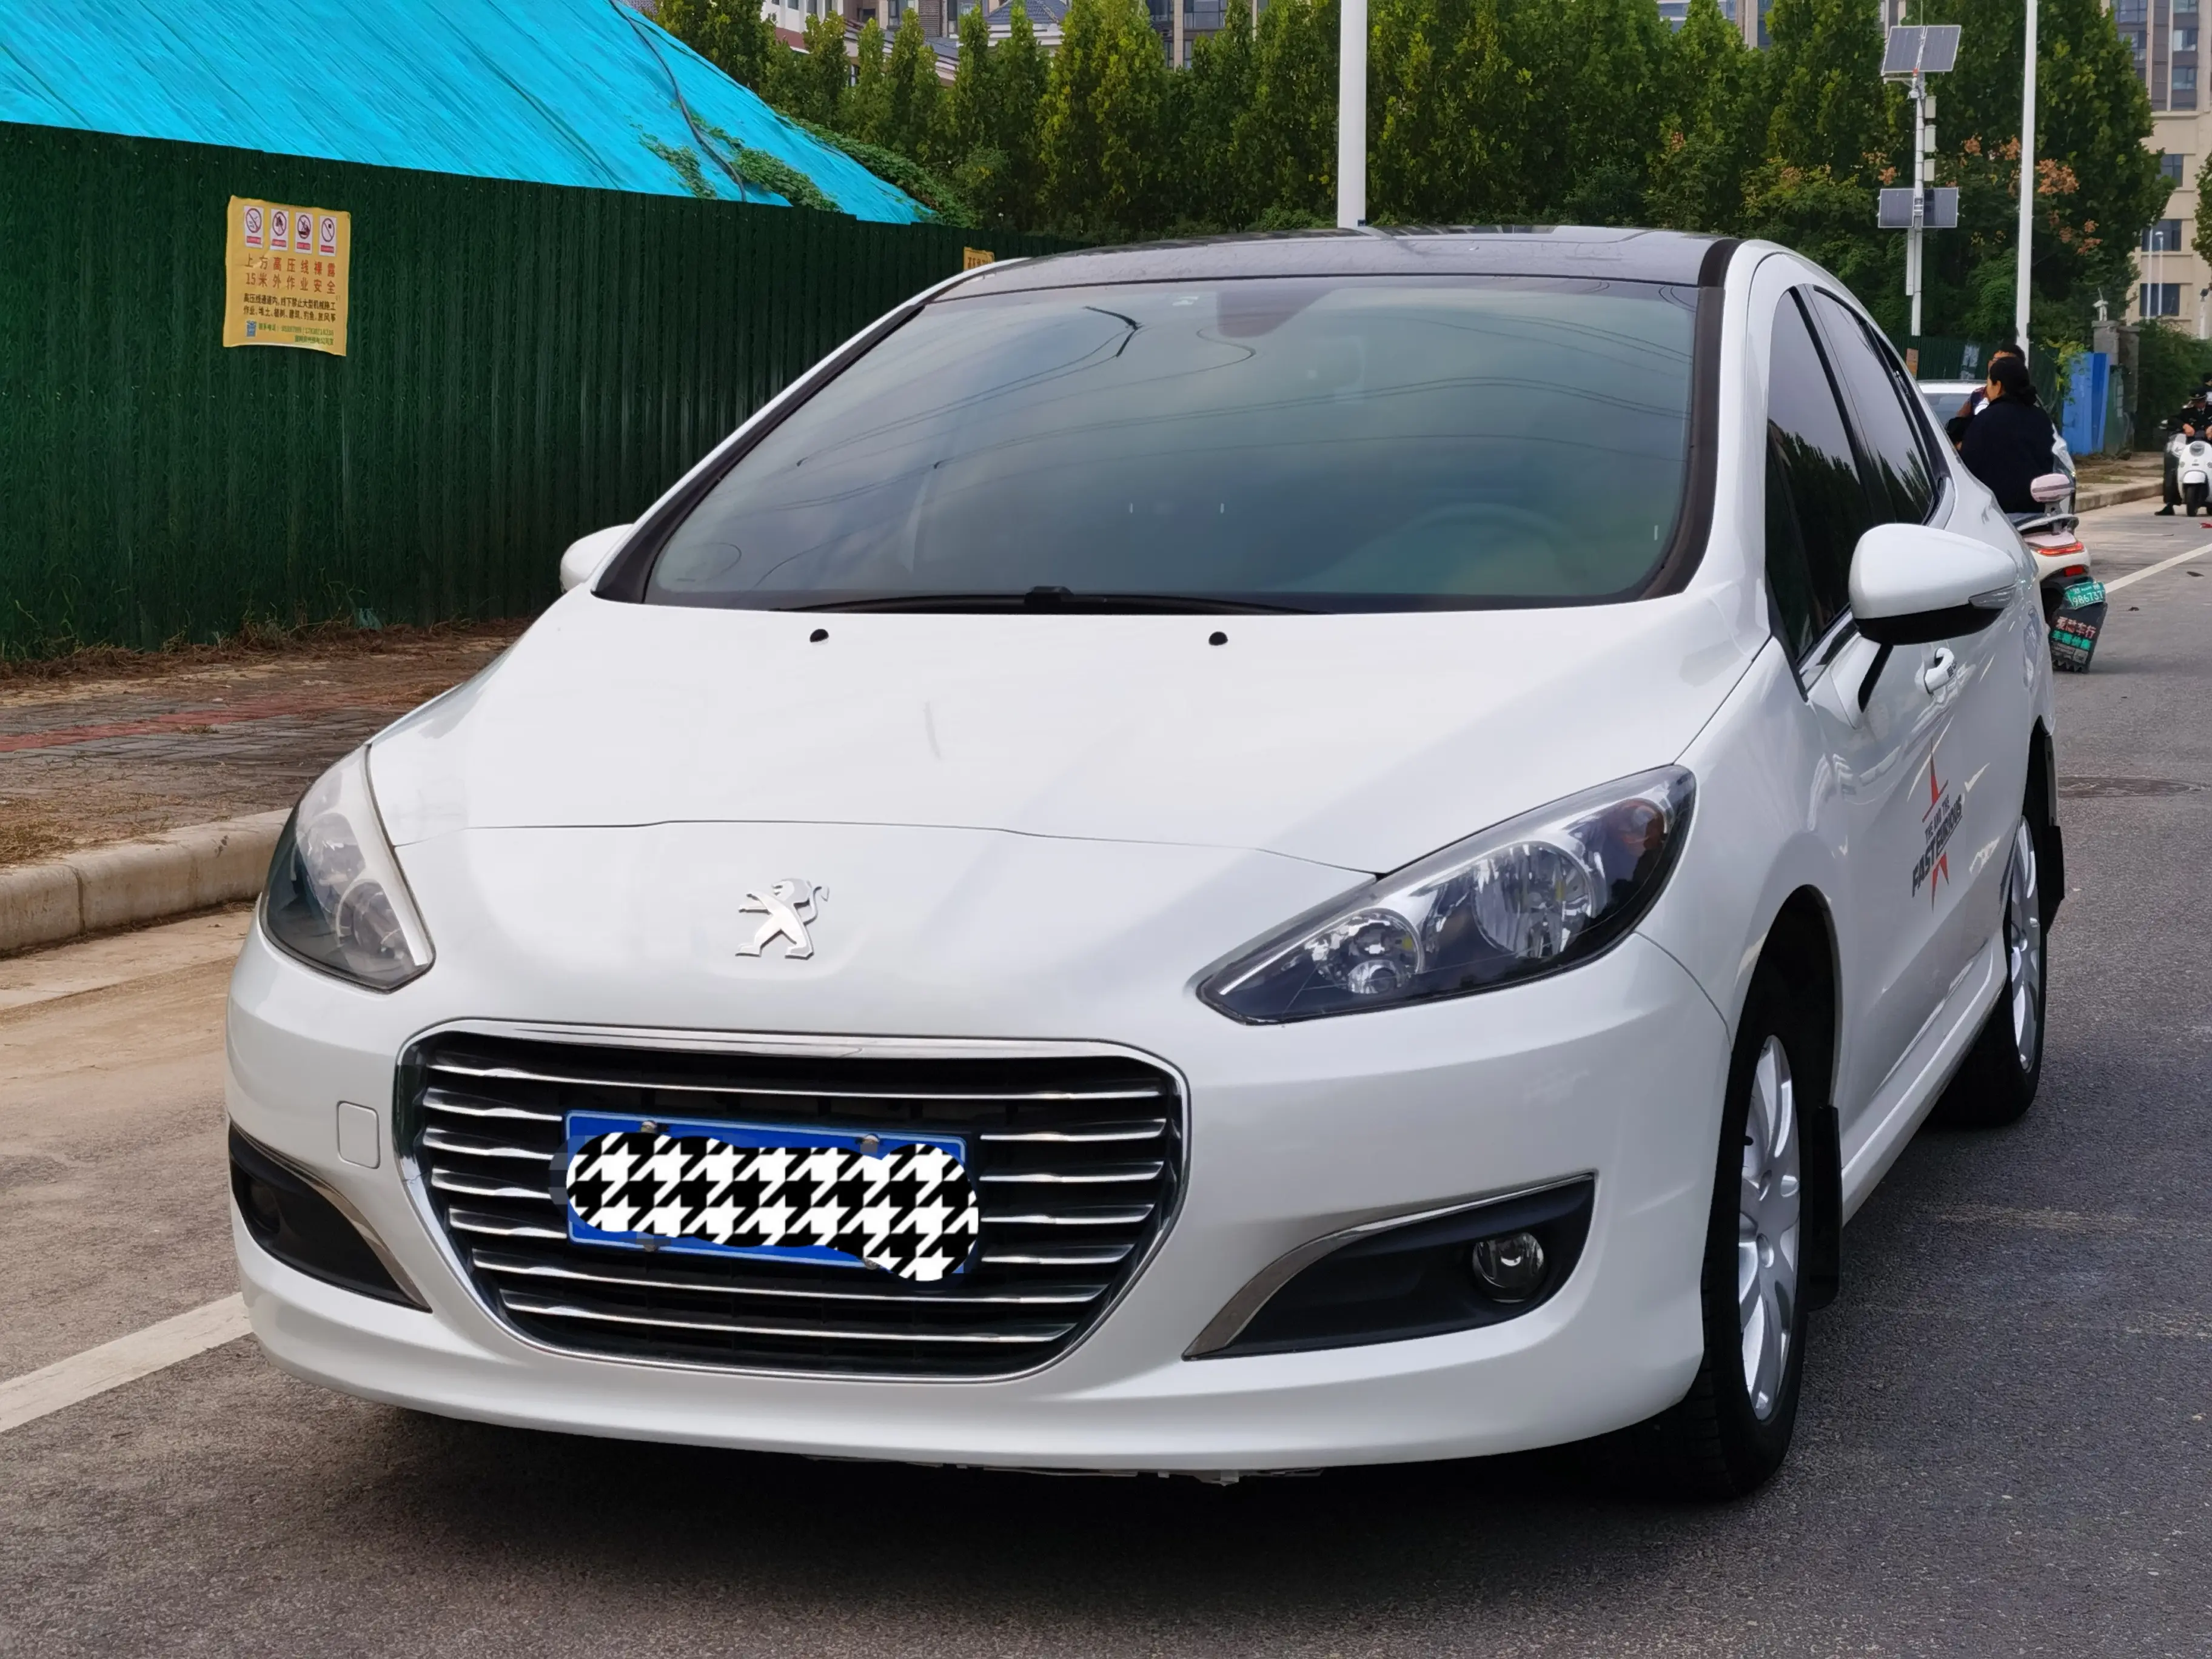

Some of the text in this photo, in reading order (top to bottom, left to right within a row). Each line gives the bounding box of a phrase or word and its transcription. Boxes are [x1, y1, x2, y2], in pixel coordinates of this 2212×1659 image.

[244, 252, 336, 278] 上方高压线裸露
[245, 272, 336, 295] 15米外作业安全
